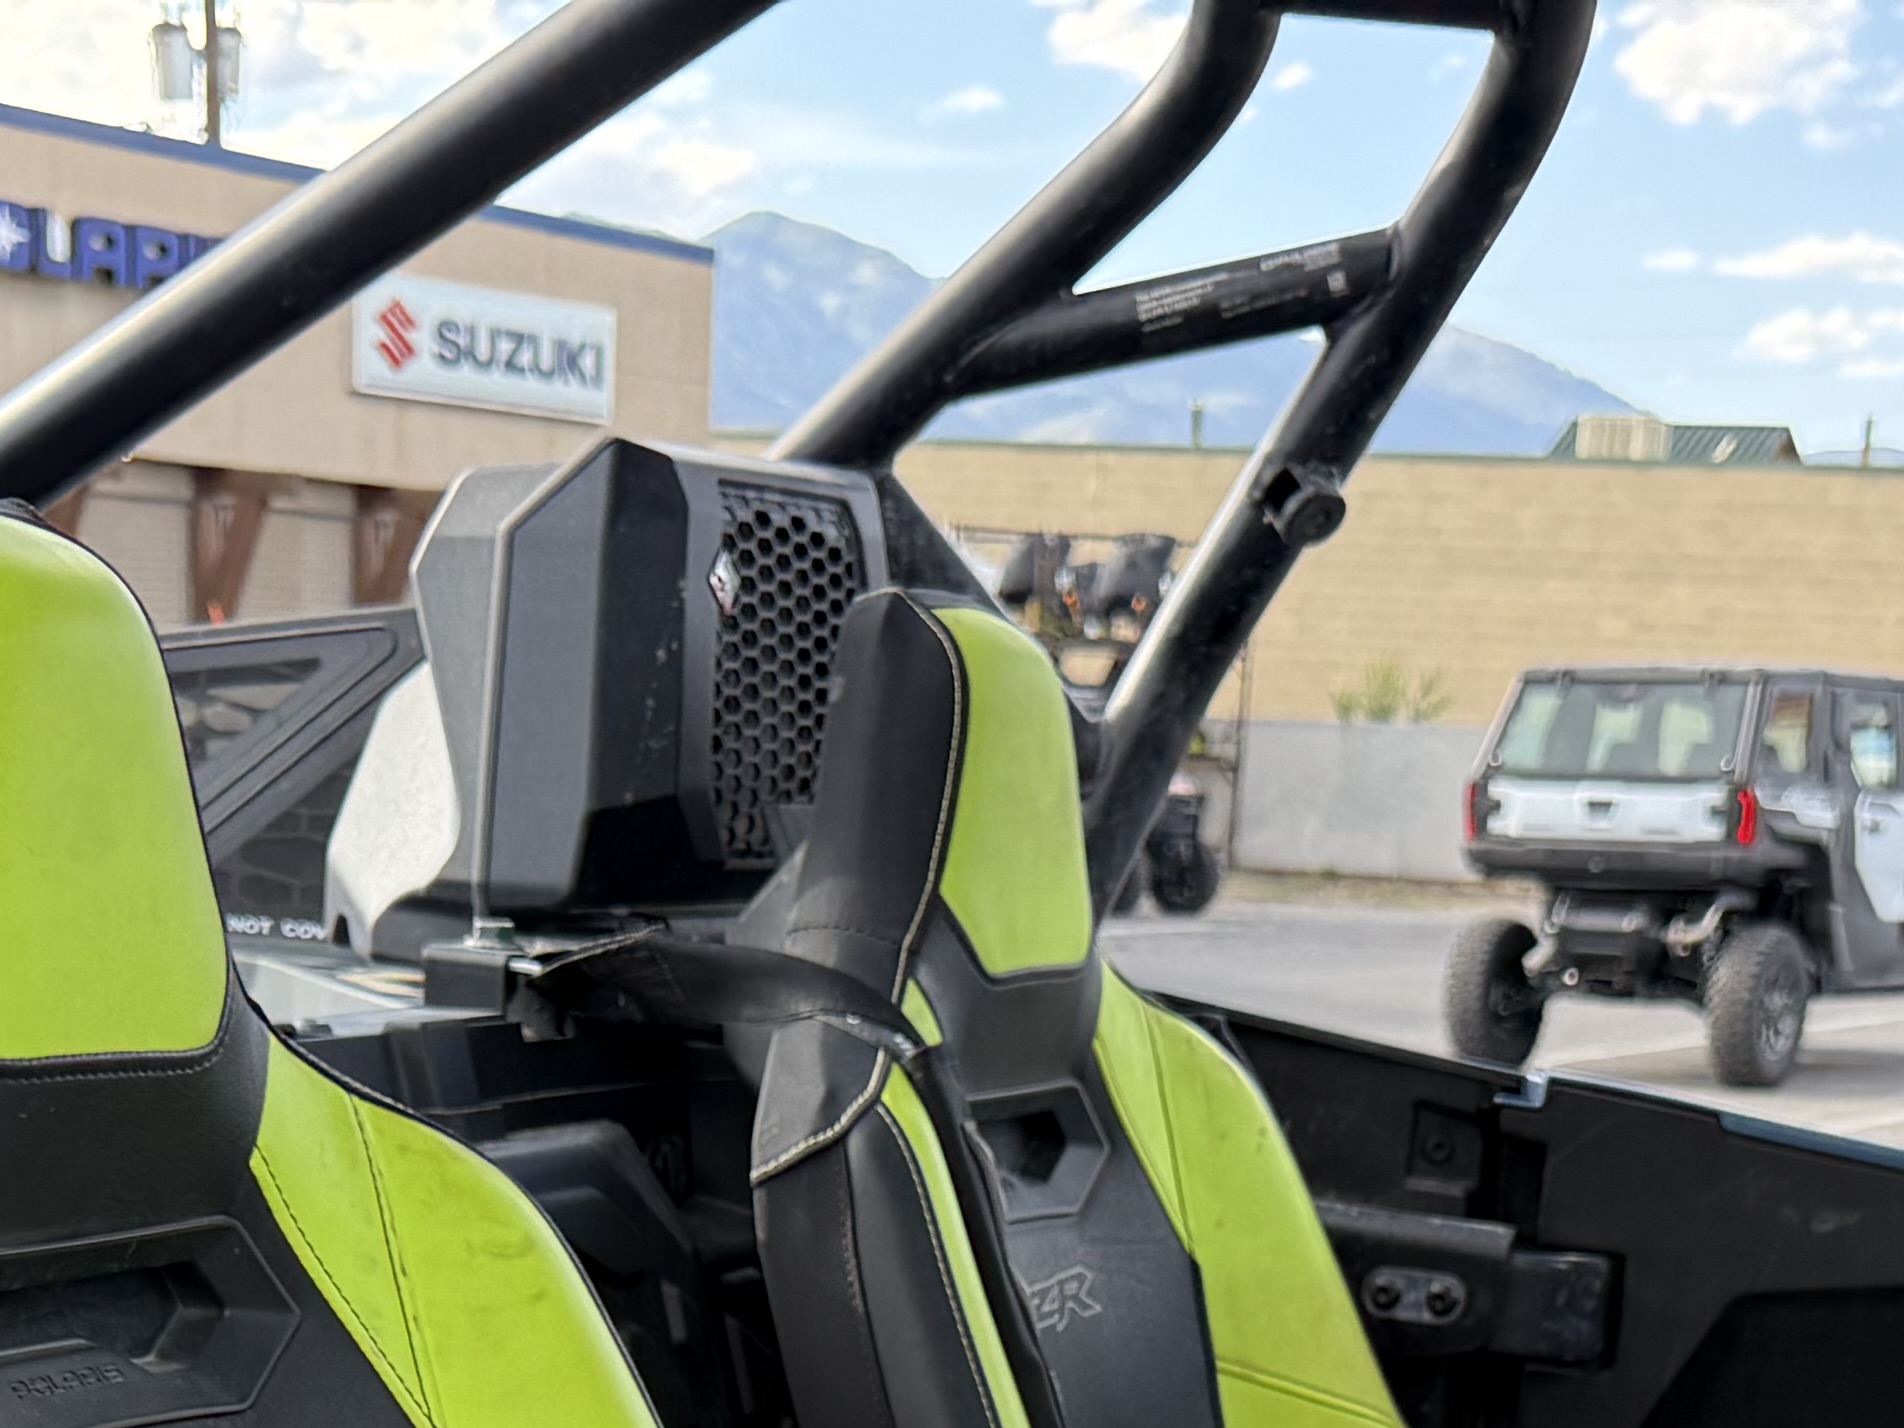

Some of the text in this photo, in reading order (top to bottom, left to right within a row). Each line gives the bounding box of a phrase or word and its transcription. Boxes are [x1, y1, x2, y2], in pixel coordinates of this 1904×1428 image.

[436, 319, 605, 394] SUZUKI
[1028, 1264, 1103, 1332] ZR
[8, 1363, 126, 1401] POLARIS
